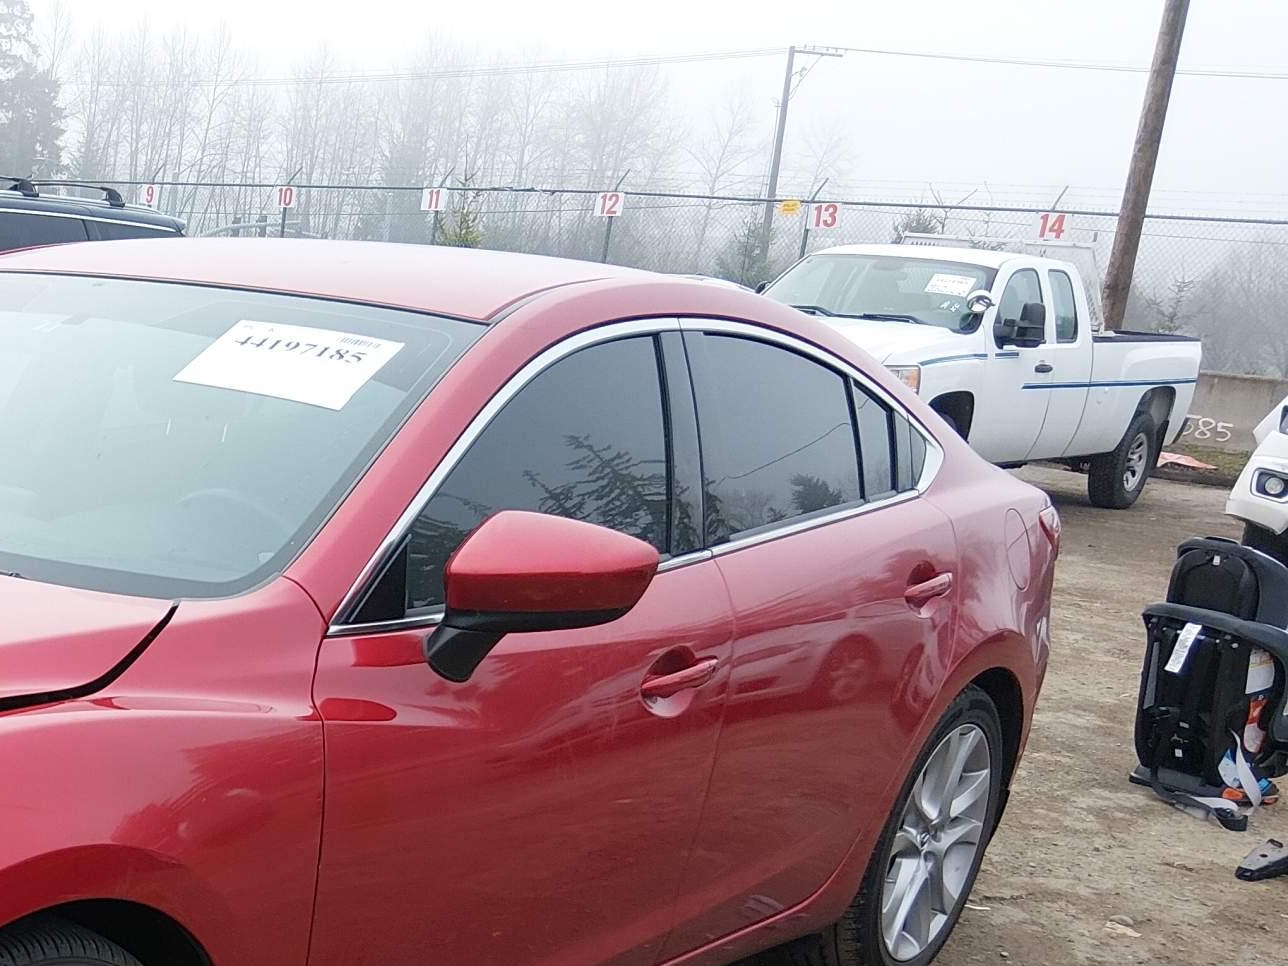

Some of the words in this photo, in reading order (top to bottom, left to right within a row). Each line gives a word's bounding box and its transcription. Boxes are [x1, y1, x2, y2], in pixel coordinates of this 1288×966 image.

[146, 186, 154, 203] 9
[278, 187, 293, 206] 10
[428, 189, 441, 209] 11
[599, 193, 619, 215] 12
[814, 203, 838, 227] 13
[1038, 213, 1066, 239] 14
[234, 335, 367, 363] 44197185
